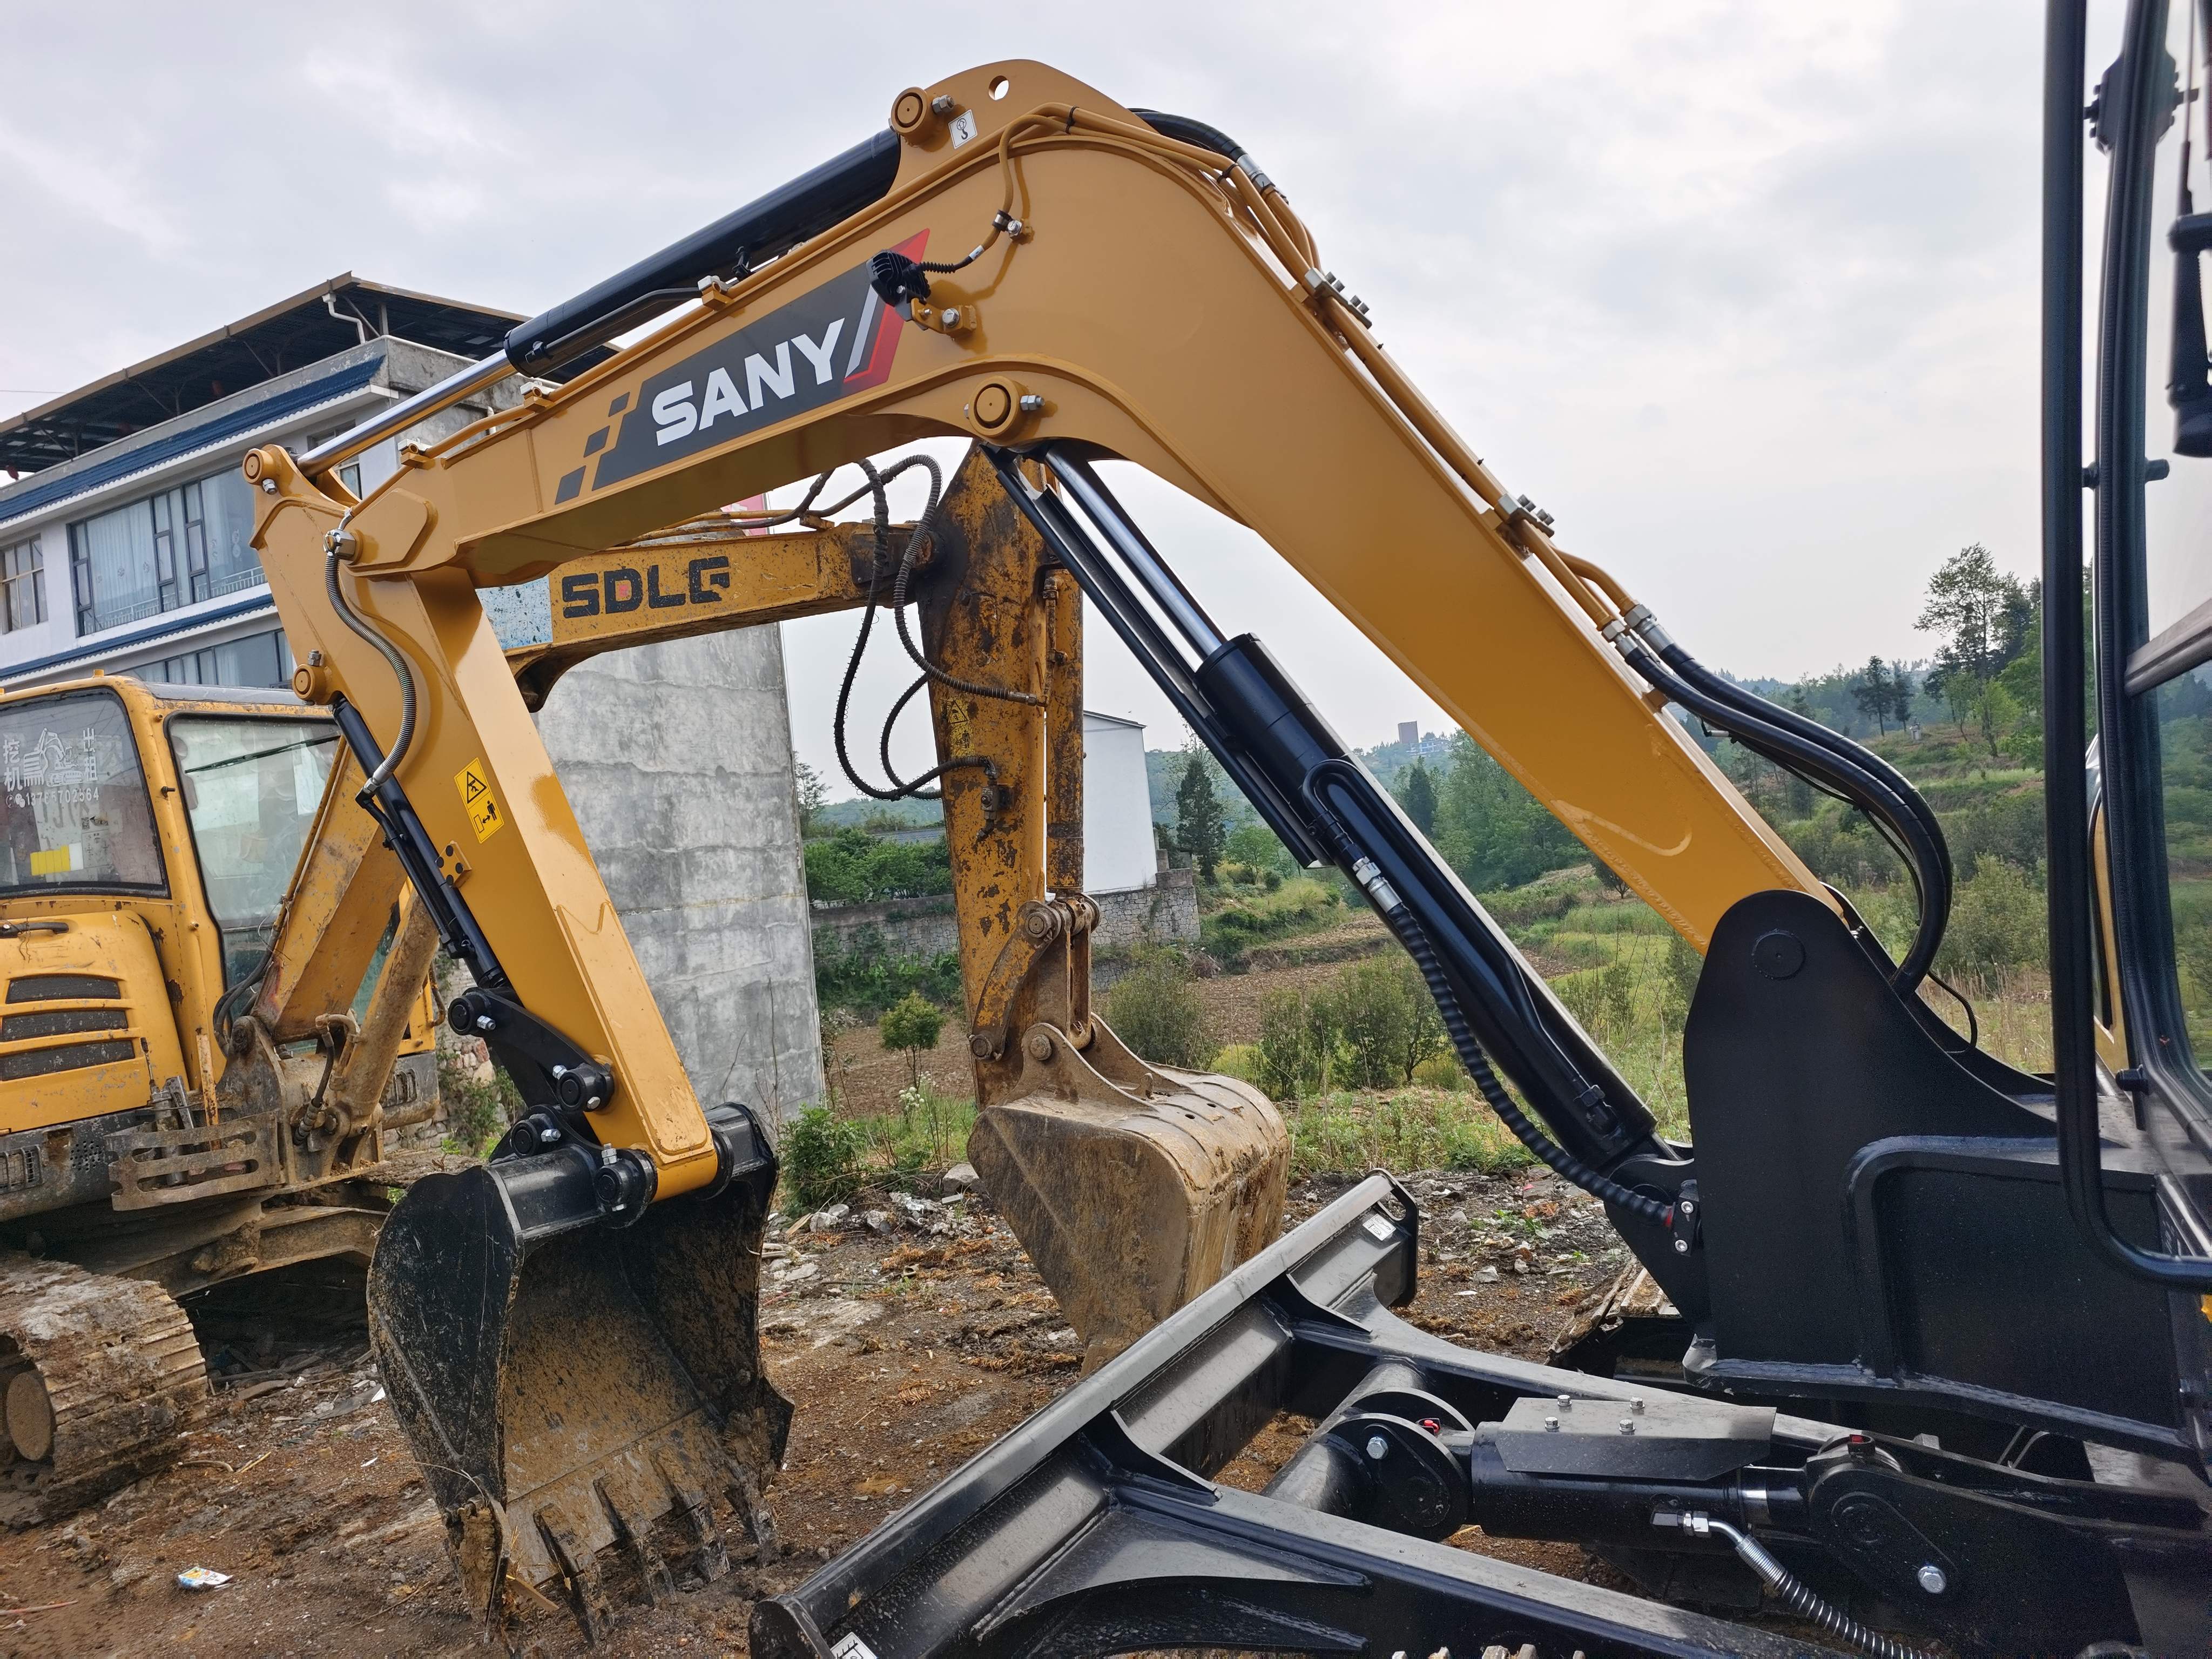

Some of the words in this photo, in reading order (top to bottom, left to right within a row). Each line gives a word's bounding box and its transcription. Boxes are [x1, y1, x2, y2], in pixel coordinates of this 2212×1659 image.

[652, 318, 845, 446] SANY
[562, 556, 730, 618] SDLG
[3, 739, 23, 792] 挖机
[83, 727, 98, 781] 出租
